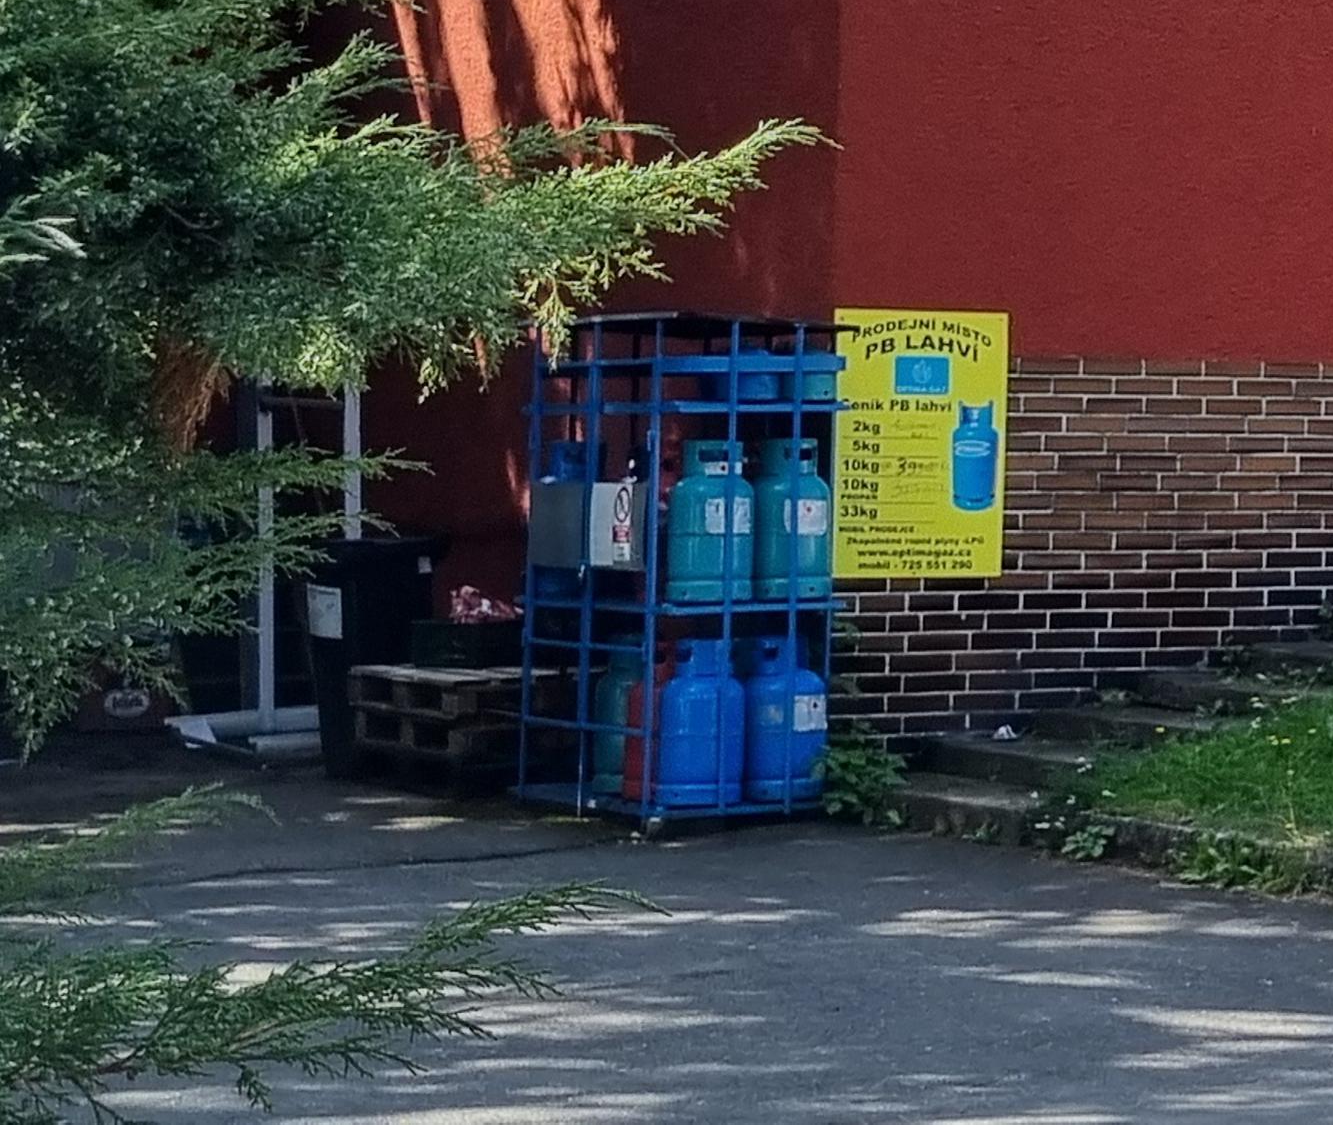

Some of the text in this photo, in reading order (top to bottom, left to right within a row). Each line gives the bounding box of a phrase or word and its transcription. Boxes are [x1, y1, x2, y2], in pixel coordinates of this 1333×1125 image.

[865, 335, 978, 363] PB LAHVÍ
[889, 399, 910, 412] PB
[853, 421, 880, 435] 2kg
[852, 440, 880, 454] 5kg
[843, 459, 880, 473] 10kg
[842, 478, 879, 493] 10kg
[840, 505, 878, 520] 33kg
